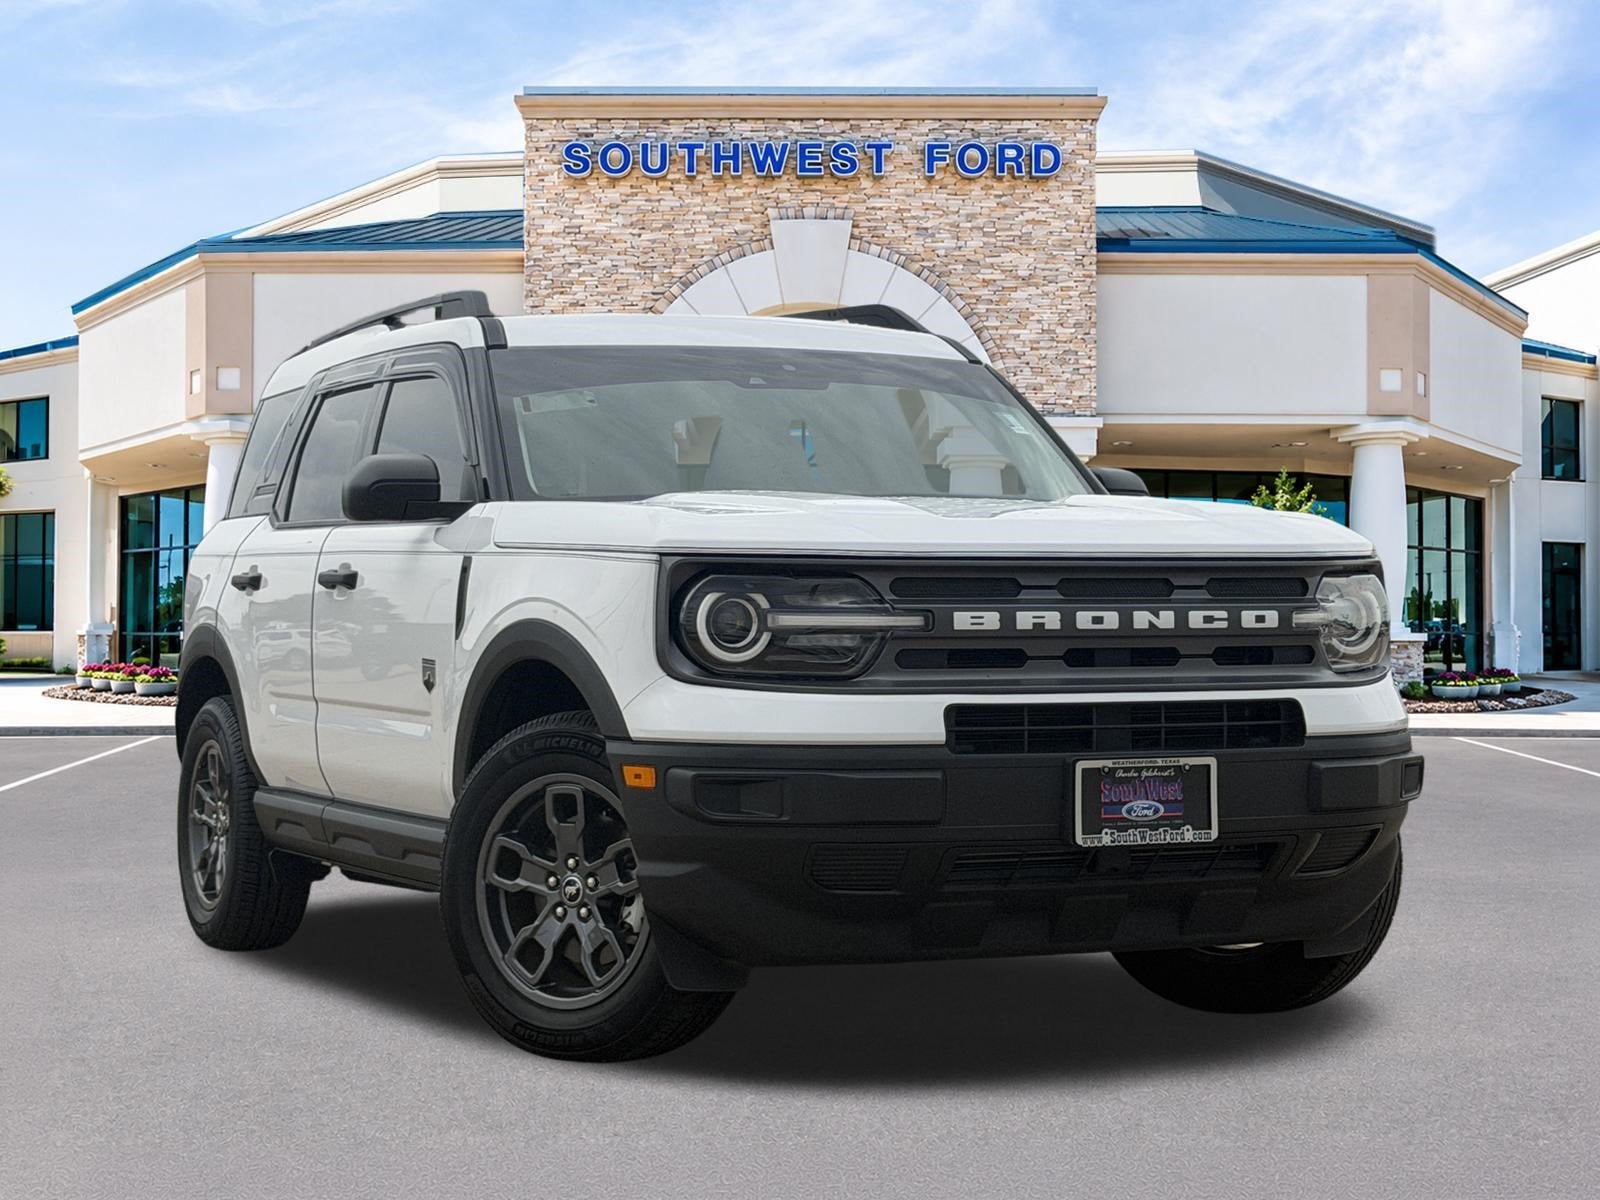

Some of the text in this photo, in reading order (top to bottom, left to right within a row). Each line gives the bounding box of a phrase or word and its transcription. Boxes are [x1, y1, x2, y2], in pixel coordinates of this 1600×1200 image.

[562, 141, 1063, 177] SOUTHWEST FORD
[953, 610, 1279, 630] BRONCO
[1131, 804, 1156, 817] Ford
[1082, 827, 1212, 846] www.SouthWestFord.com
